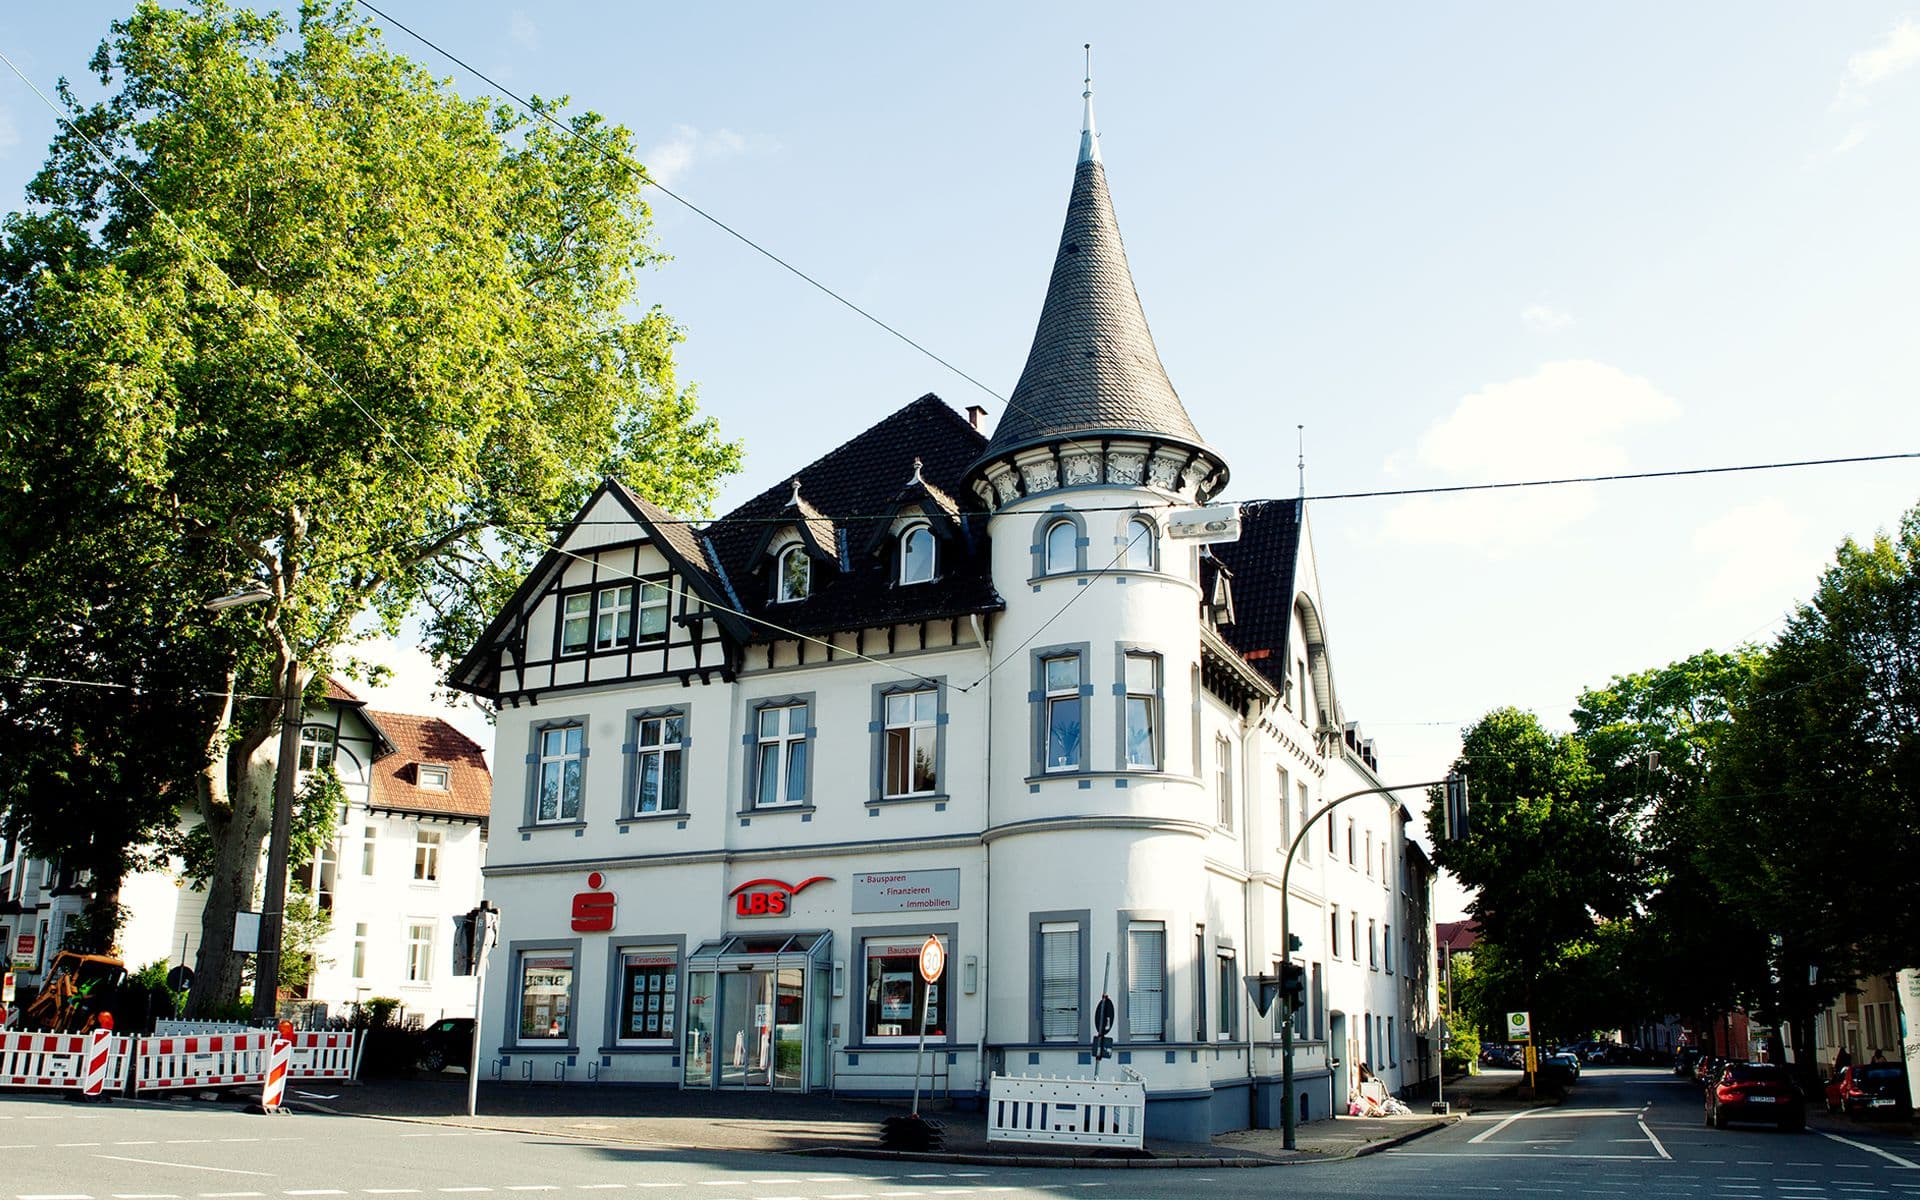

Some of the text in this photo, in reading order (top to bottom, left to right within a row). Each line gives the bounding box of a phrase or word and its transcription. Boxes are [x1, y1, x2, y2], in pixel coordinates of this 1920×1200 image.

[867, 875, 906, 884] Bausparen
[886, 887, 930, 895] Finanzieren
[736, 891, 785, 915] LBS
[906, 899, 950, 908] Immobilien
[888, 946, 921, 955] Bauspare
[926, 952, 939, 970] 30
